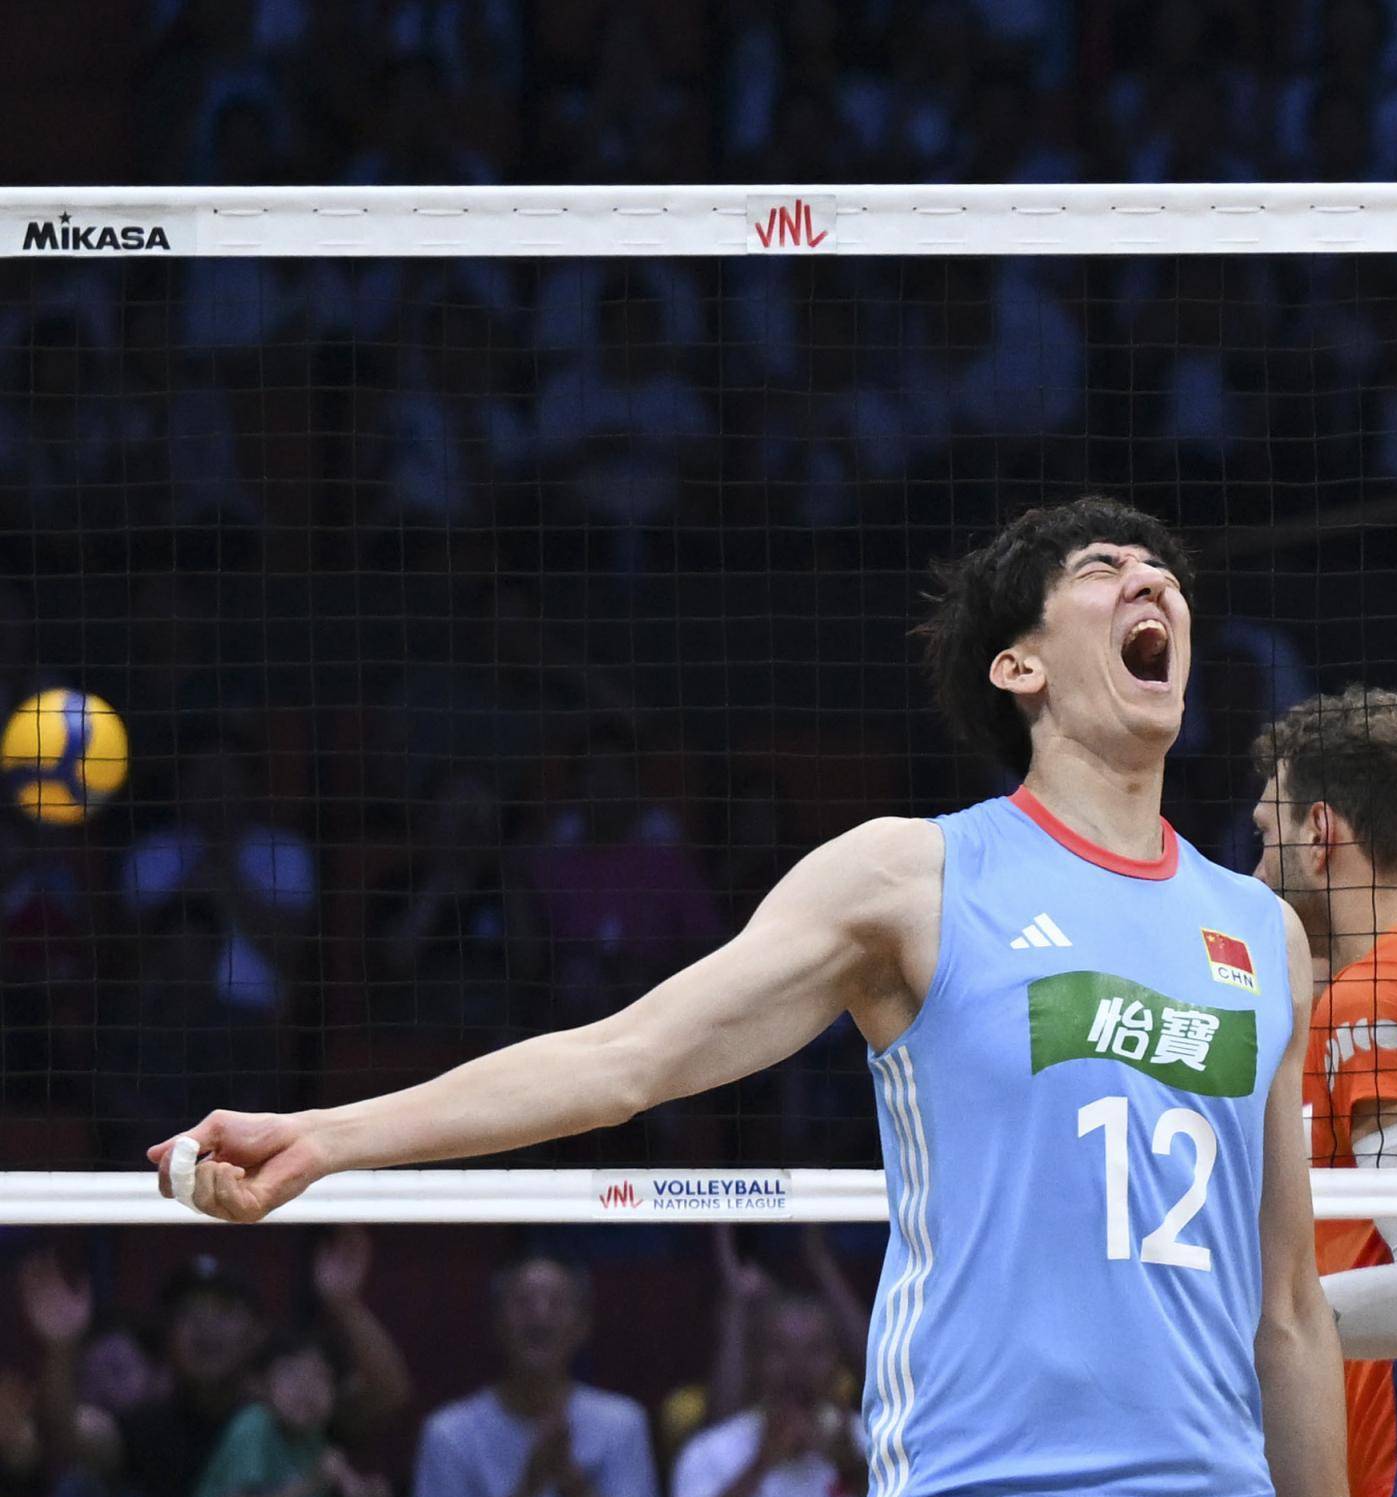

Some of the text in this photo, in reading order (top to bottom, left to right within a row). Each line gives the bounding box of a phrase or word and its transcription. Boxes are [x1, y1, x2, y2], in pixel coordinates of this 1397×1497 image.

[755, 199, 829, 248] VNL
[1218, 966, 1254, 988] CHN
[1087, 997, 1220, 1071] 怡寶
[600, 1180, 643, 1208] VNL
[653, 1180, 785, 1195] VOLLEYBALL
[1078, 1096, 1217, 1272] 12
[653, 1197, 785, 1210] NATIONS LEAGUE
